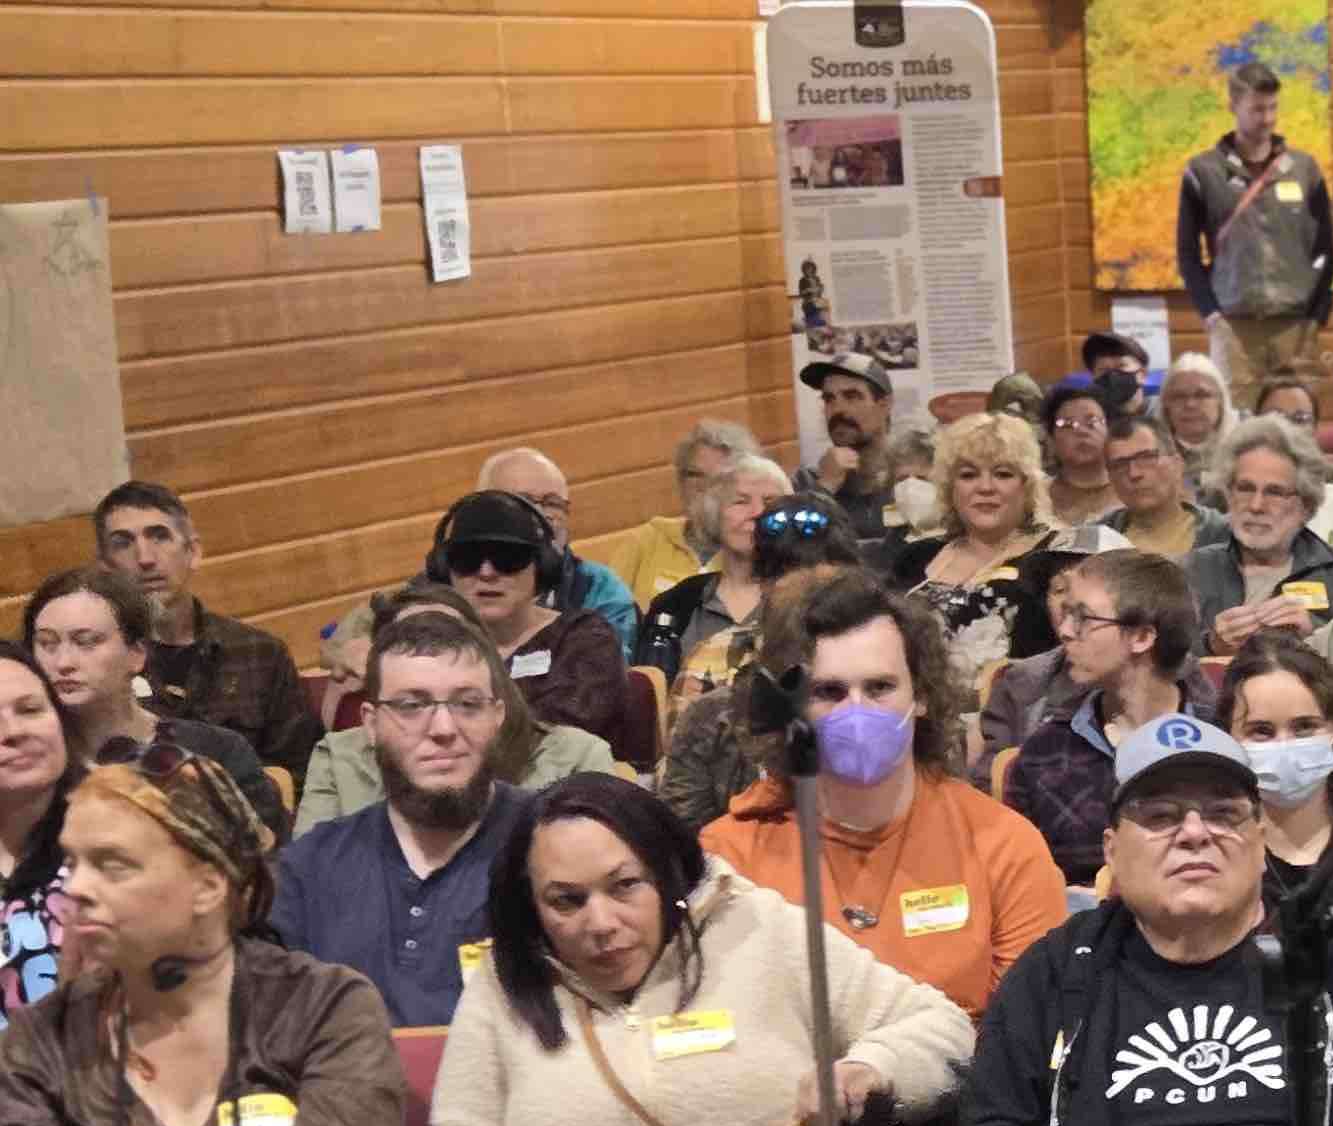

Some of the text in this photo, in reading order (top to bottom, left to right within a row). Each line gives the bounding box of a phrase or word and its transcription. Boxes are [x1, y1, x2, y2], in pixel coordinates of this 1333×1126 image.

[810, 52, 955, 79] Somos más
[797, 81, 972, 110] fuertes juntes
[1133, 1081, 1248, 1104] PCUN
